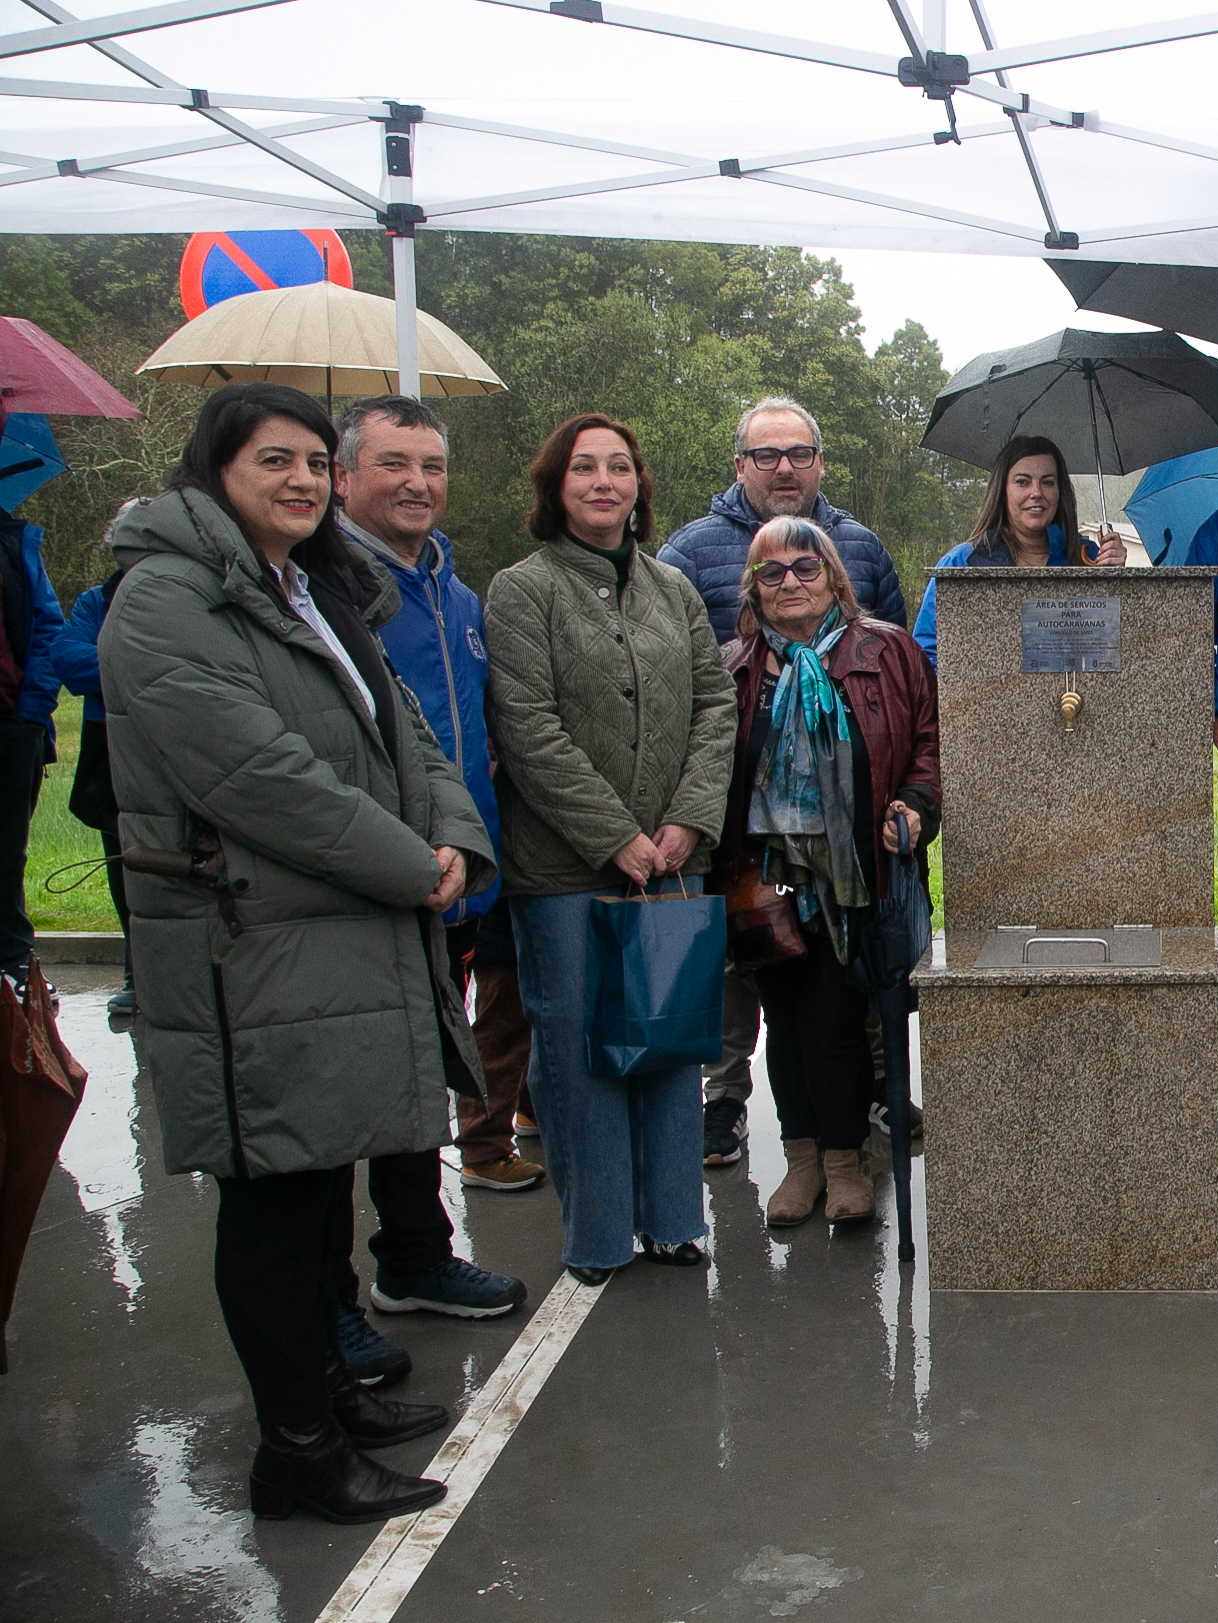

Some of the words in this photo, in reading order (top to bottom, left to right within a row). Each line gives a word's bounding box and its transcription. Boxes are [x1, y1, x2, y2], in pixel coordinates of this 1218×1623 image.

[1035, 600, 1056, 608] ÁREA
[1058, 601, 1068, 609] DE
[1070, 601, 1107, 609] SERVIZOS
[1037, 620, 1106, 628] AUTOCARAVANAS
